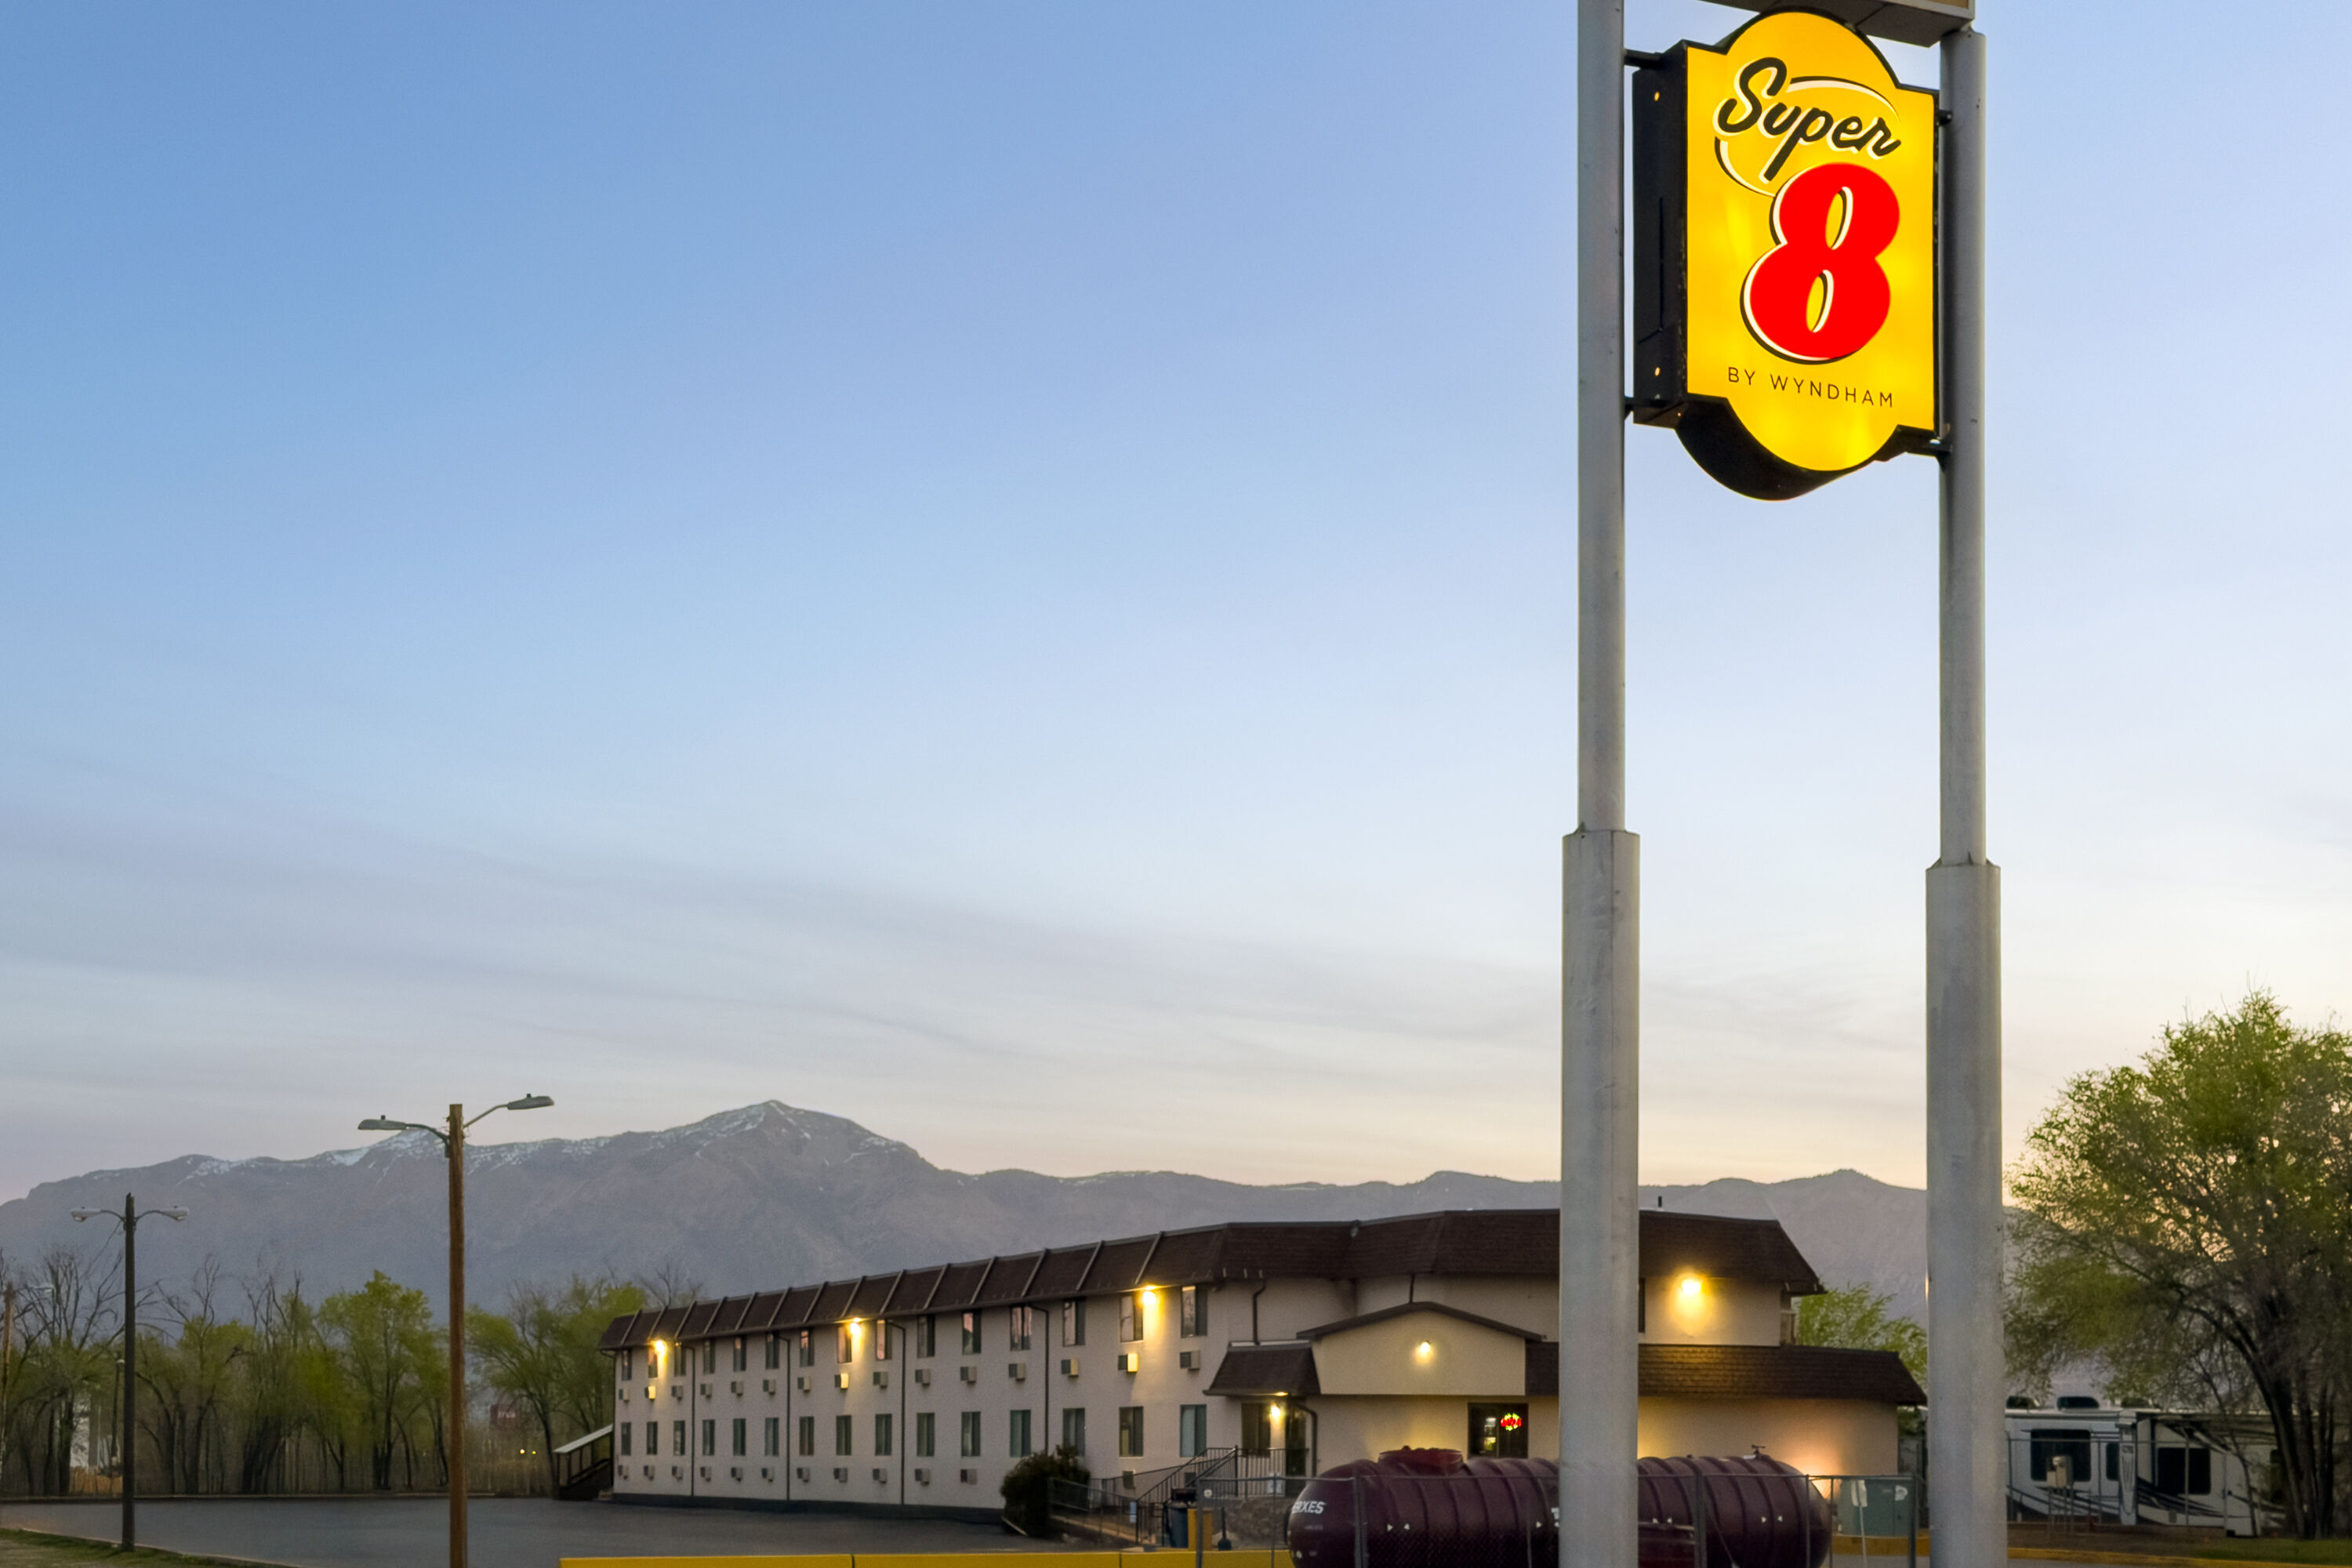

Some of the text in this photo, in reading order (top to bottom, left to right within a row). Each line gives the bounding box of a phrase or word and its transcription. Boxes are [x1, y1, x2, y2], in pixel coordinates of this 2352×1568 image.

[1714, 57, 1901, 183] Super
[1740, 162, 1900, 365] 8
[1728, 366, 1893, 408] BY WYNDHAM
